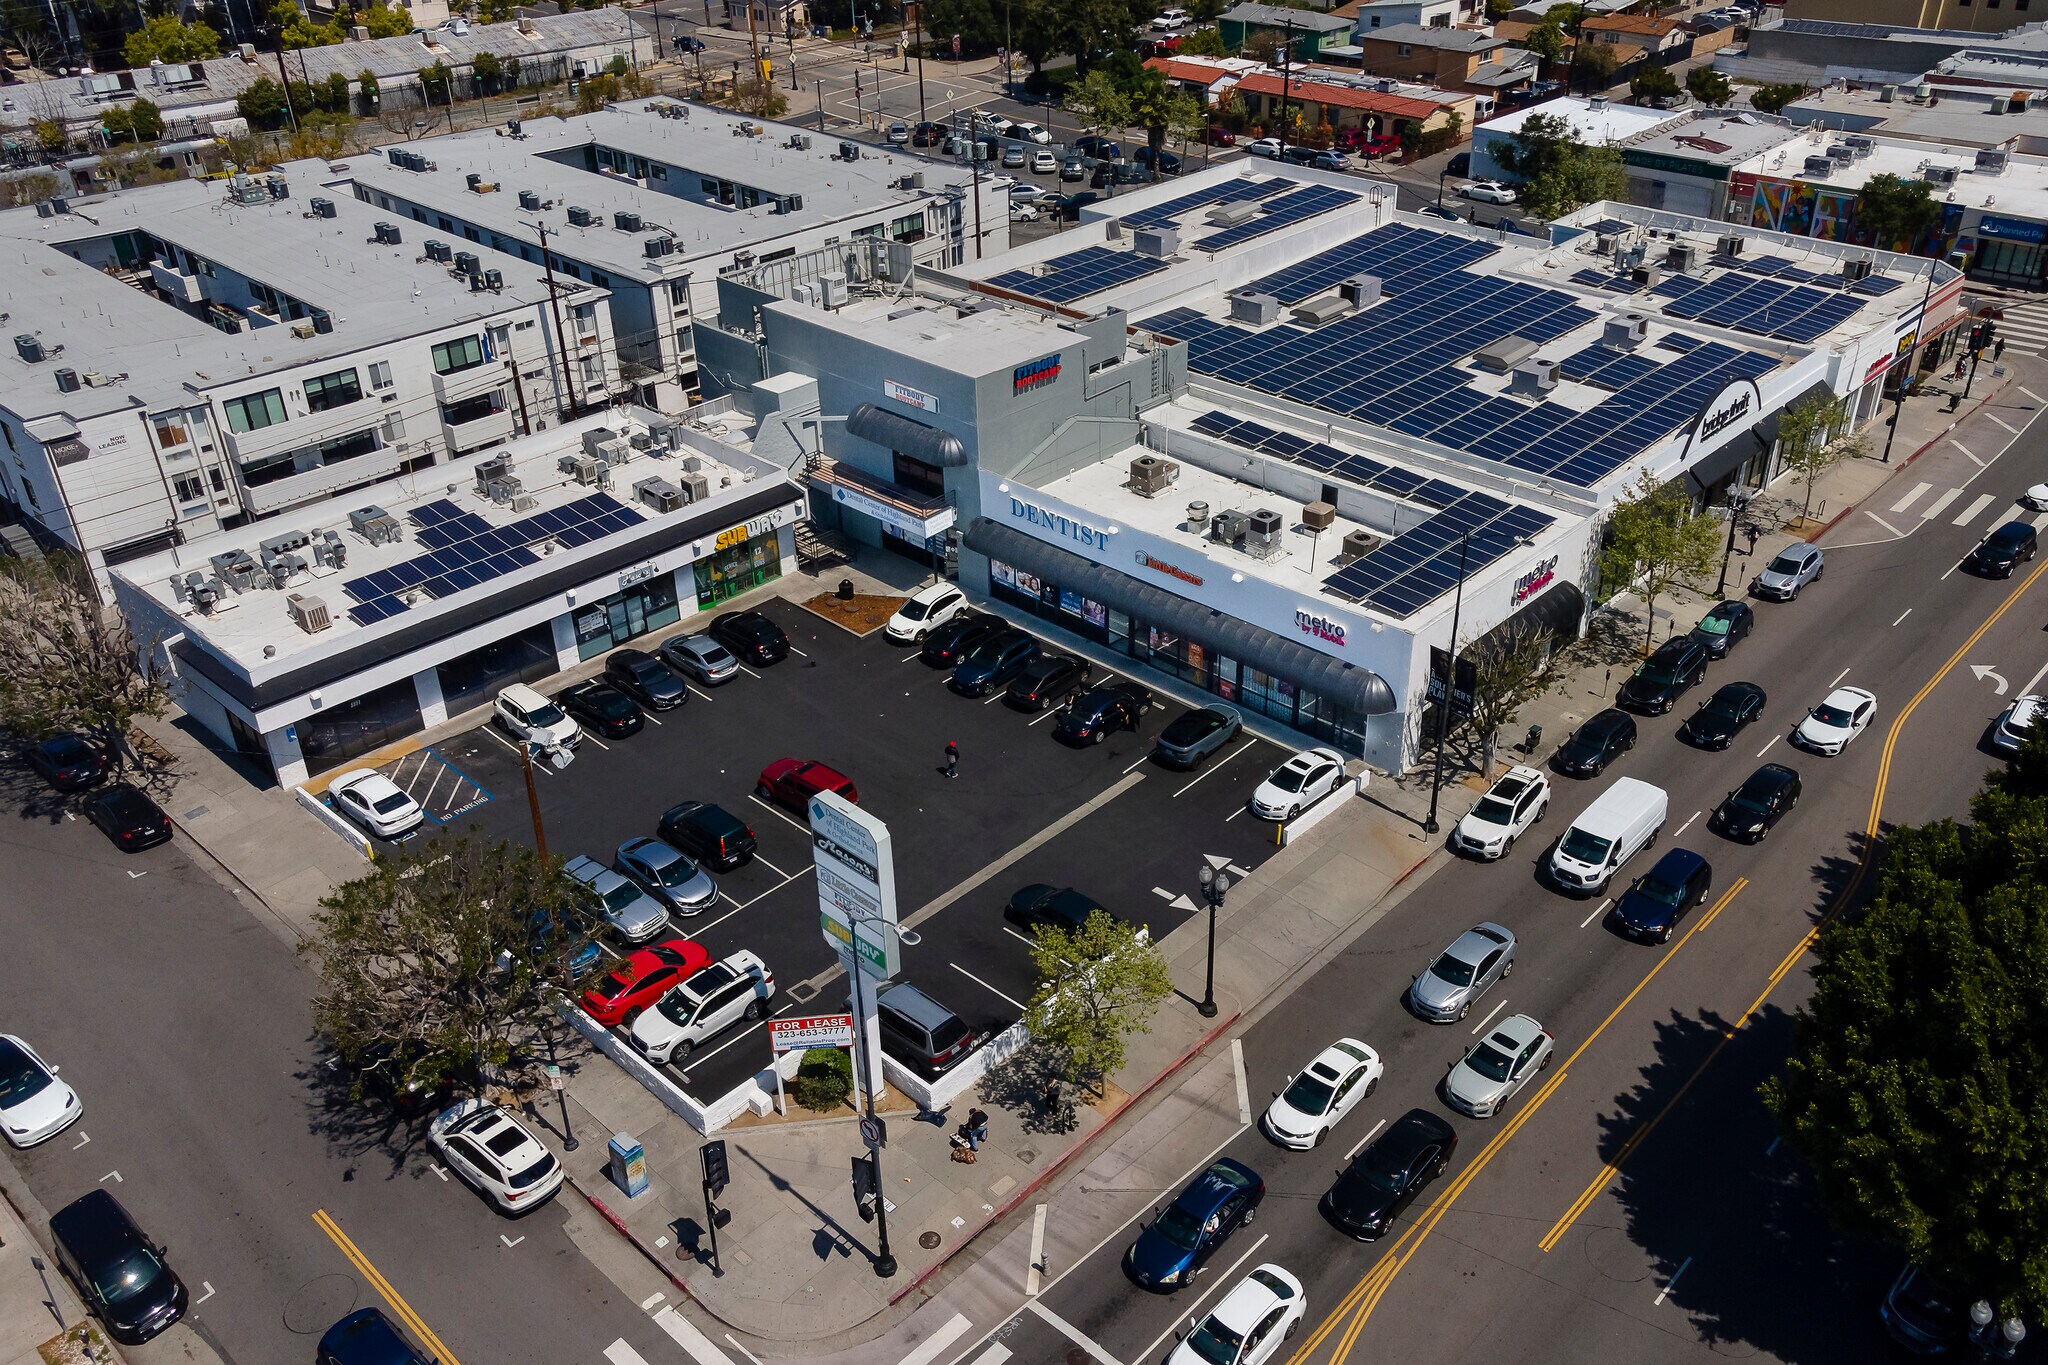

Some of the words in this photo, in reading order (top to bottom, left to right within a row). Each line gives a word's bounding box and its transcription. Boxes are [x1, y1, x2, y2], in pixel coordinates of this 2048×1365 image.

[1628, 155, 1651, 166] MADE
[1655, 159, 1666, 168] BY
[1668, 161, 1704, 174] PILATES
[1995, 224, 2030, 237] Planned
[1015, 353, 1061, 380] FITBODY
[1015, 365, 1062, 389] BOOTCAMP
[1702, 409, 1730, 436] bridge
[1729, 391, 1750, 418] thrift
[98, 439, 127, 450] LEASING
[110, 434, 125, 442] NOW
[846, 492, 863, 504] Dental
[864, 499, 880, 511] Center
[887, 509, 911, 524] Highland
[911, 517, 924, 529] Park
[1010, 496, 1109, 551] DENTIST
[714, 509, 783, 551] SUBWAY
[1296, 609, 1346, 637] metro
[1428, 685, 1446, 700] PLAY
[440, 813, 453, 821] NO
[454, 796, 489, 815] PARKING
[825, 808, 845, 825] Dental
[846, 821, 866, 839] Center
[826, 819, 833, 829] of
[834, 823, 861, 845] Highland
[862, 841, 876, 855] Park
[818, 839, 871, 876] Mason's
[775, 1021, 800, 1030] FOR
[806, 1017, 847, 1028] LEASE
[777, 1026, 846, 1039] 323-653-3777
